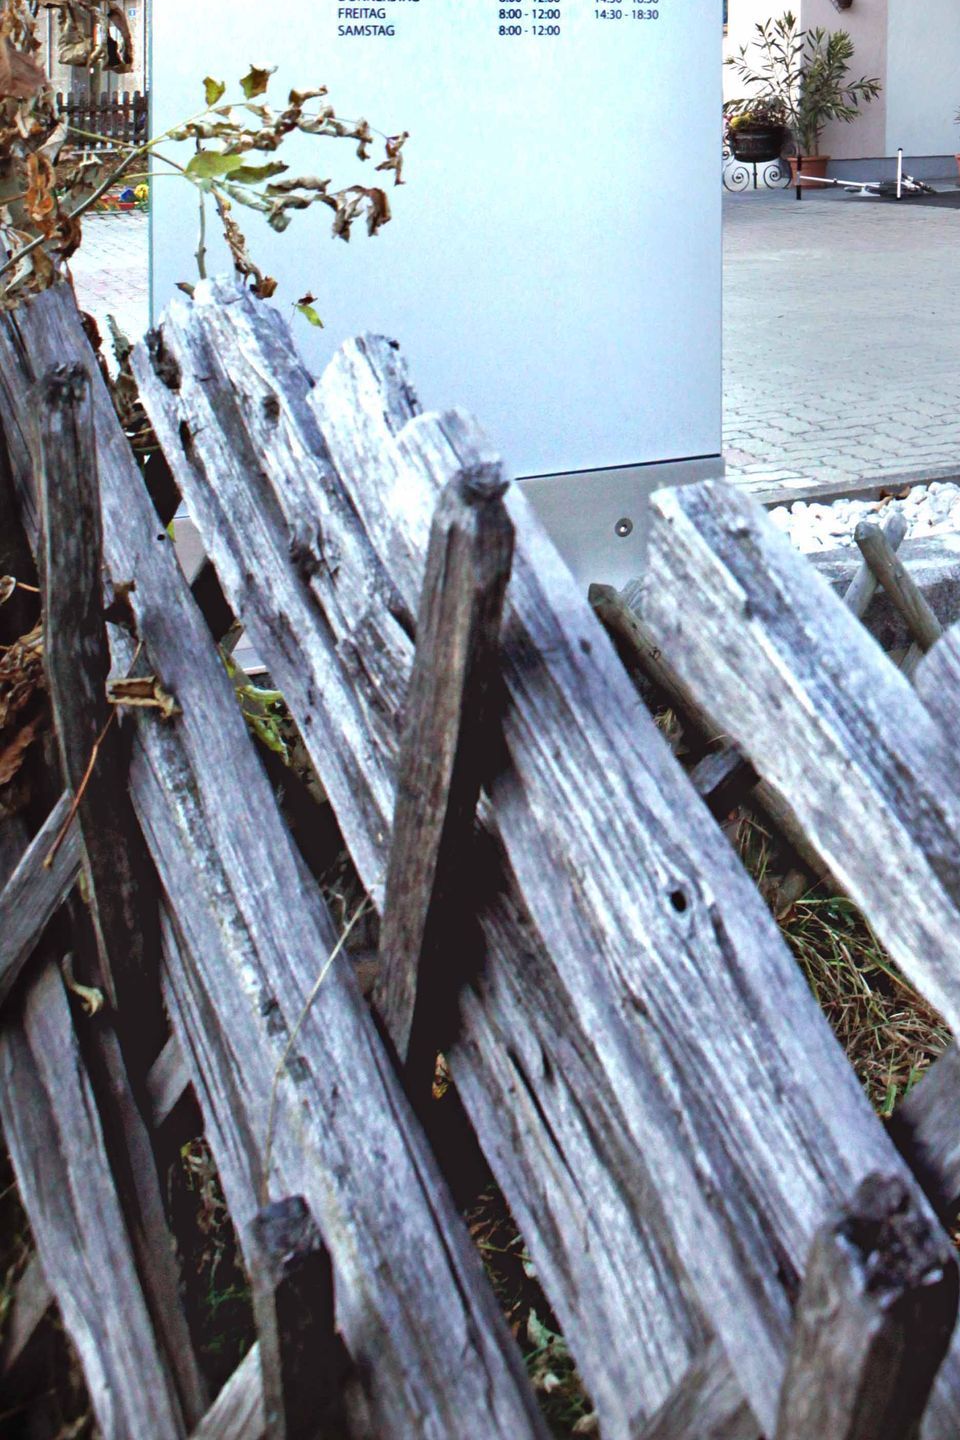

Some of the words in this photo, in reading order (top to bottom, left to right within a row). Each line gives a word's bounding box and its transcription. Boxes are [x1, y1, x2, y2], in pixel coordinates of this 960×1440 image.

[338, 8, 386, 20] FREITAG
[499, 8, 523, 19] 8:00
[532, 8, 561, 19] 12:00
[595, 8, 623, 19] 14:30
[632, 8, 660, 19] 18:30
[338, 25, 395, 37] SAMSTAG
[499, 24, 523, 35] 8:00
[532, 24, 561, 35] 12:00
